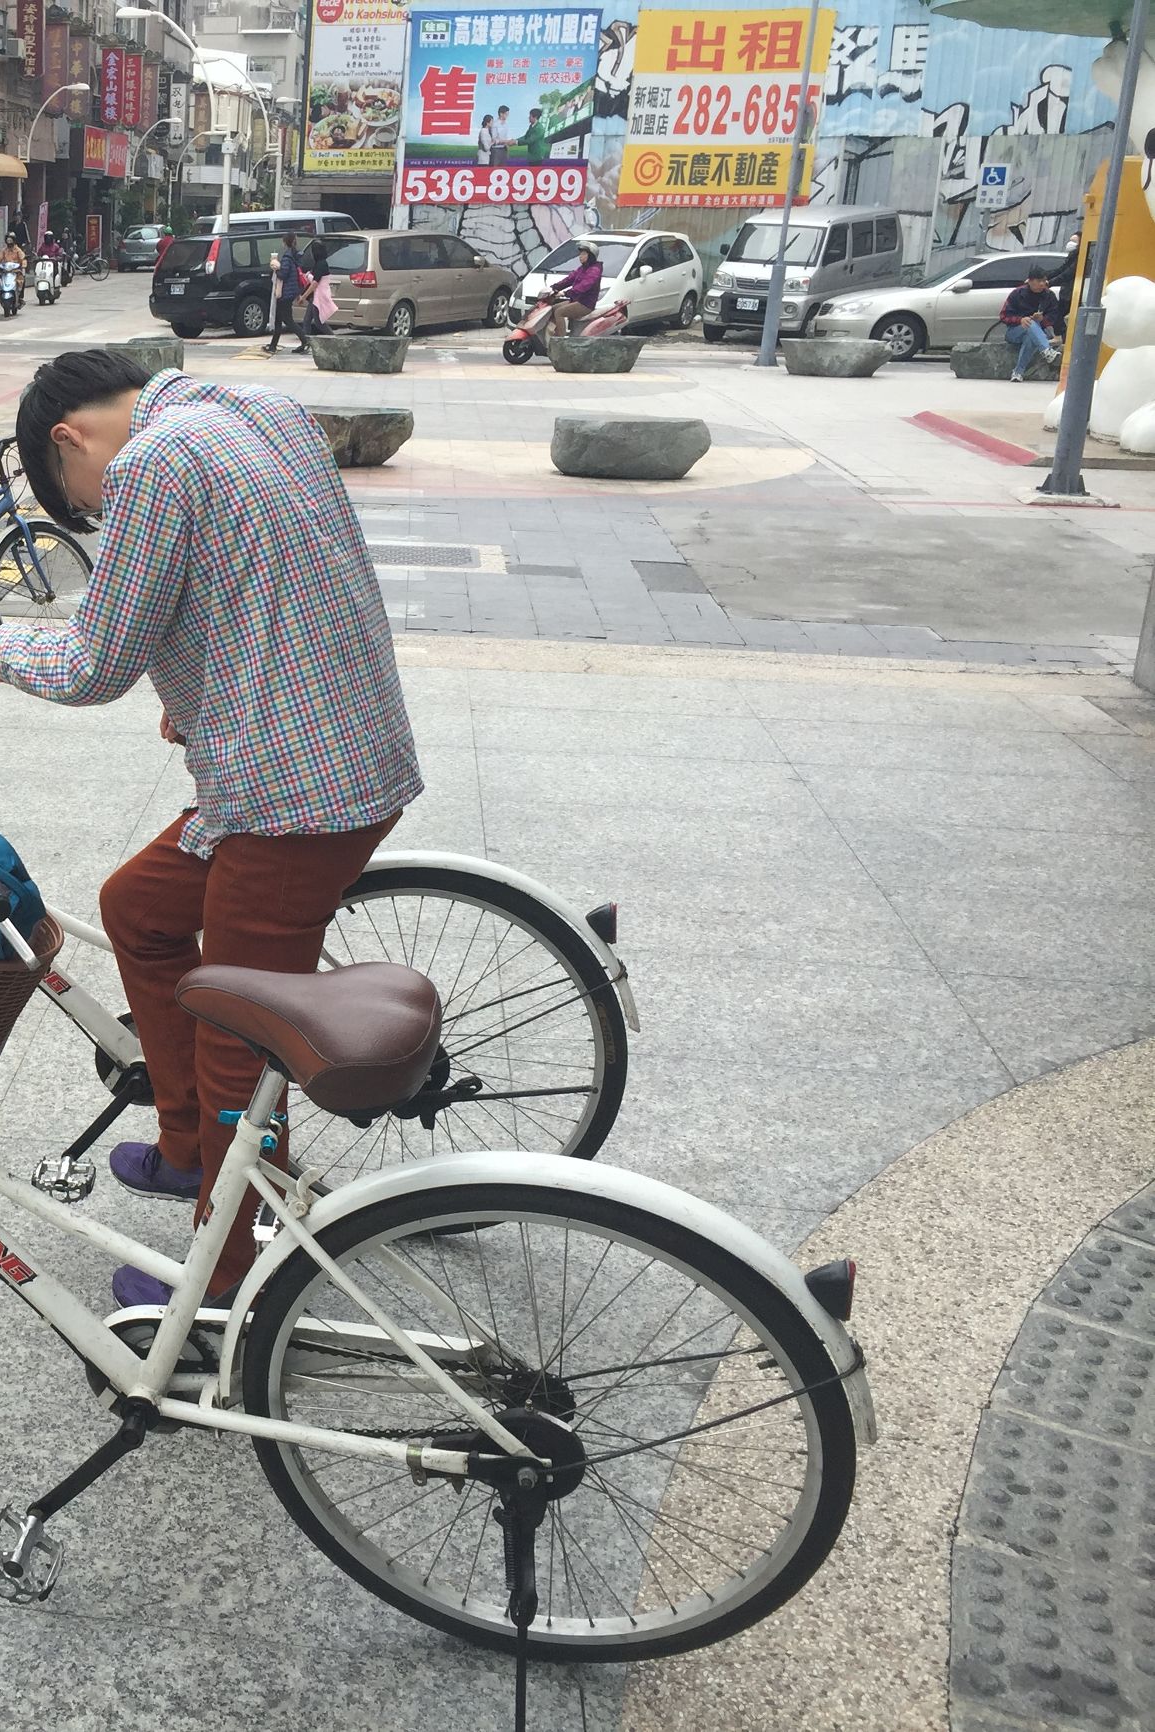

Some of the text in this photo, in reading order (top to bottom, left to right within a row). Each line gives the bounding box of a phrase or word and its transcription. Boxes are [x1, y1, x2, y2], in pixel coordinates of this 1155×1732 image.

[454, 13, 599, 46] 高雄夢時代加盟店
[666, 20, 803, 72] 出租
[420, 65, 477, 136] 售
[634, 86, 672, 109] 新堀江
[630, 113, 669, 136] 加盟店
[405, 168, 583, 202] 536-8999
[666, 152, 781, 186] 永慶不動產
